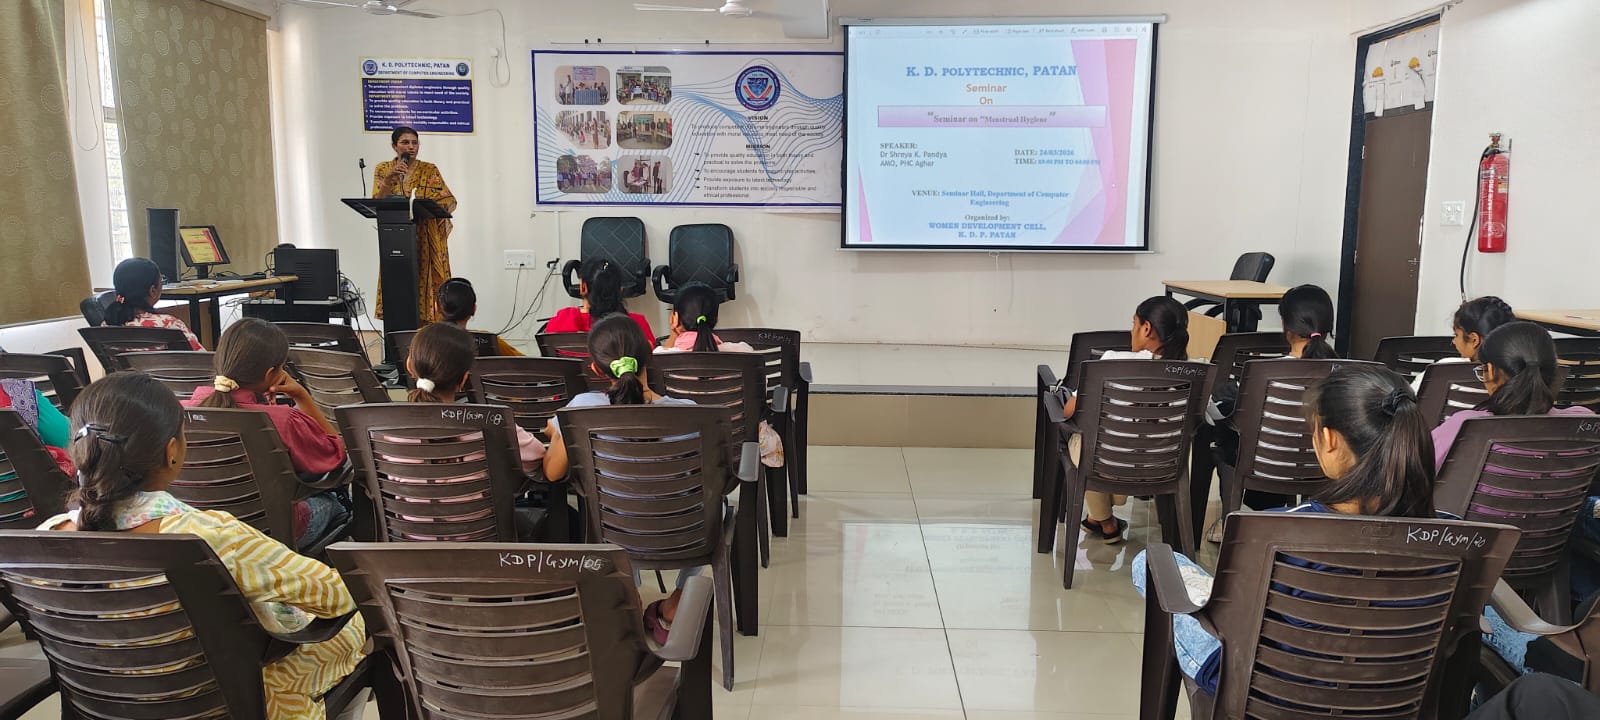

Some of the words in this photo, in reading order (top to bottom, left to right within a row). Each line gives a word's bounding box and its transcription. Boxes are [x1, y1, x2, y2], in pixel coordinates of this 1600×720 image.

[906, 66, 920, 76] K.
[925, 66, 937, 76] D.
[942, 66, 1028, 78] POLYTECHNIC,
[1033, 65, 1077, 76] PATAN
[966, 83, 1007, 92] Seminar
[979, 97, 993, 105] On
[987, 191, 1026, 199] Department
[1036, 191, 1069, 200] Computer
[970, 199, 1009, 207] Engineering
[965, 213, 998, 222] Organized
[999, 214, 1010, 222] by:
[928, 222, 960, 230] WOMEN
[962, 222, 1022, 230] DEVELOPMENT
[1024, 223, 1047, 231] CELL,
